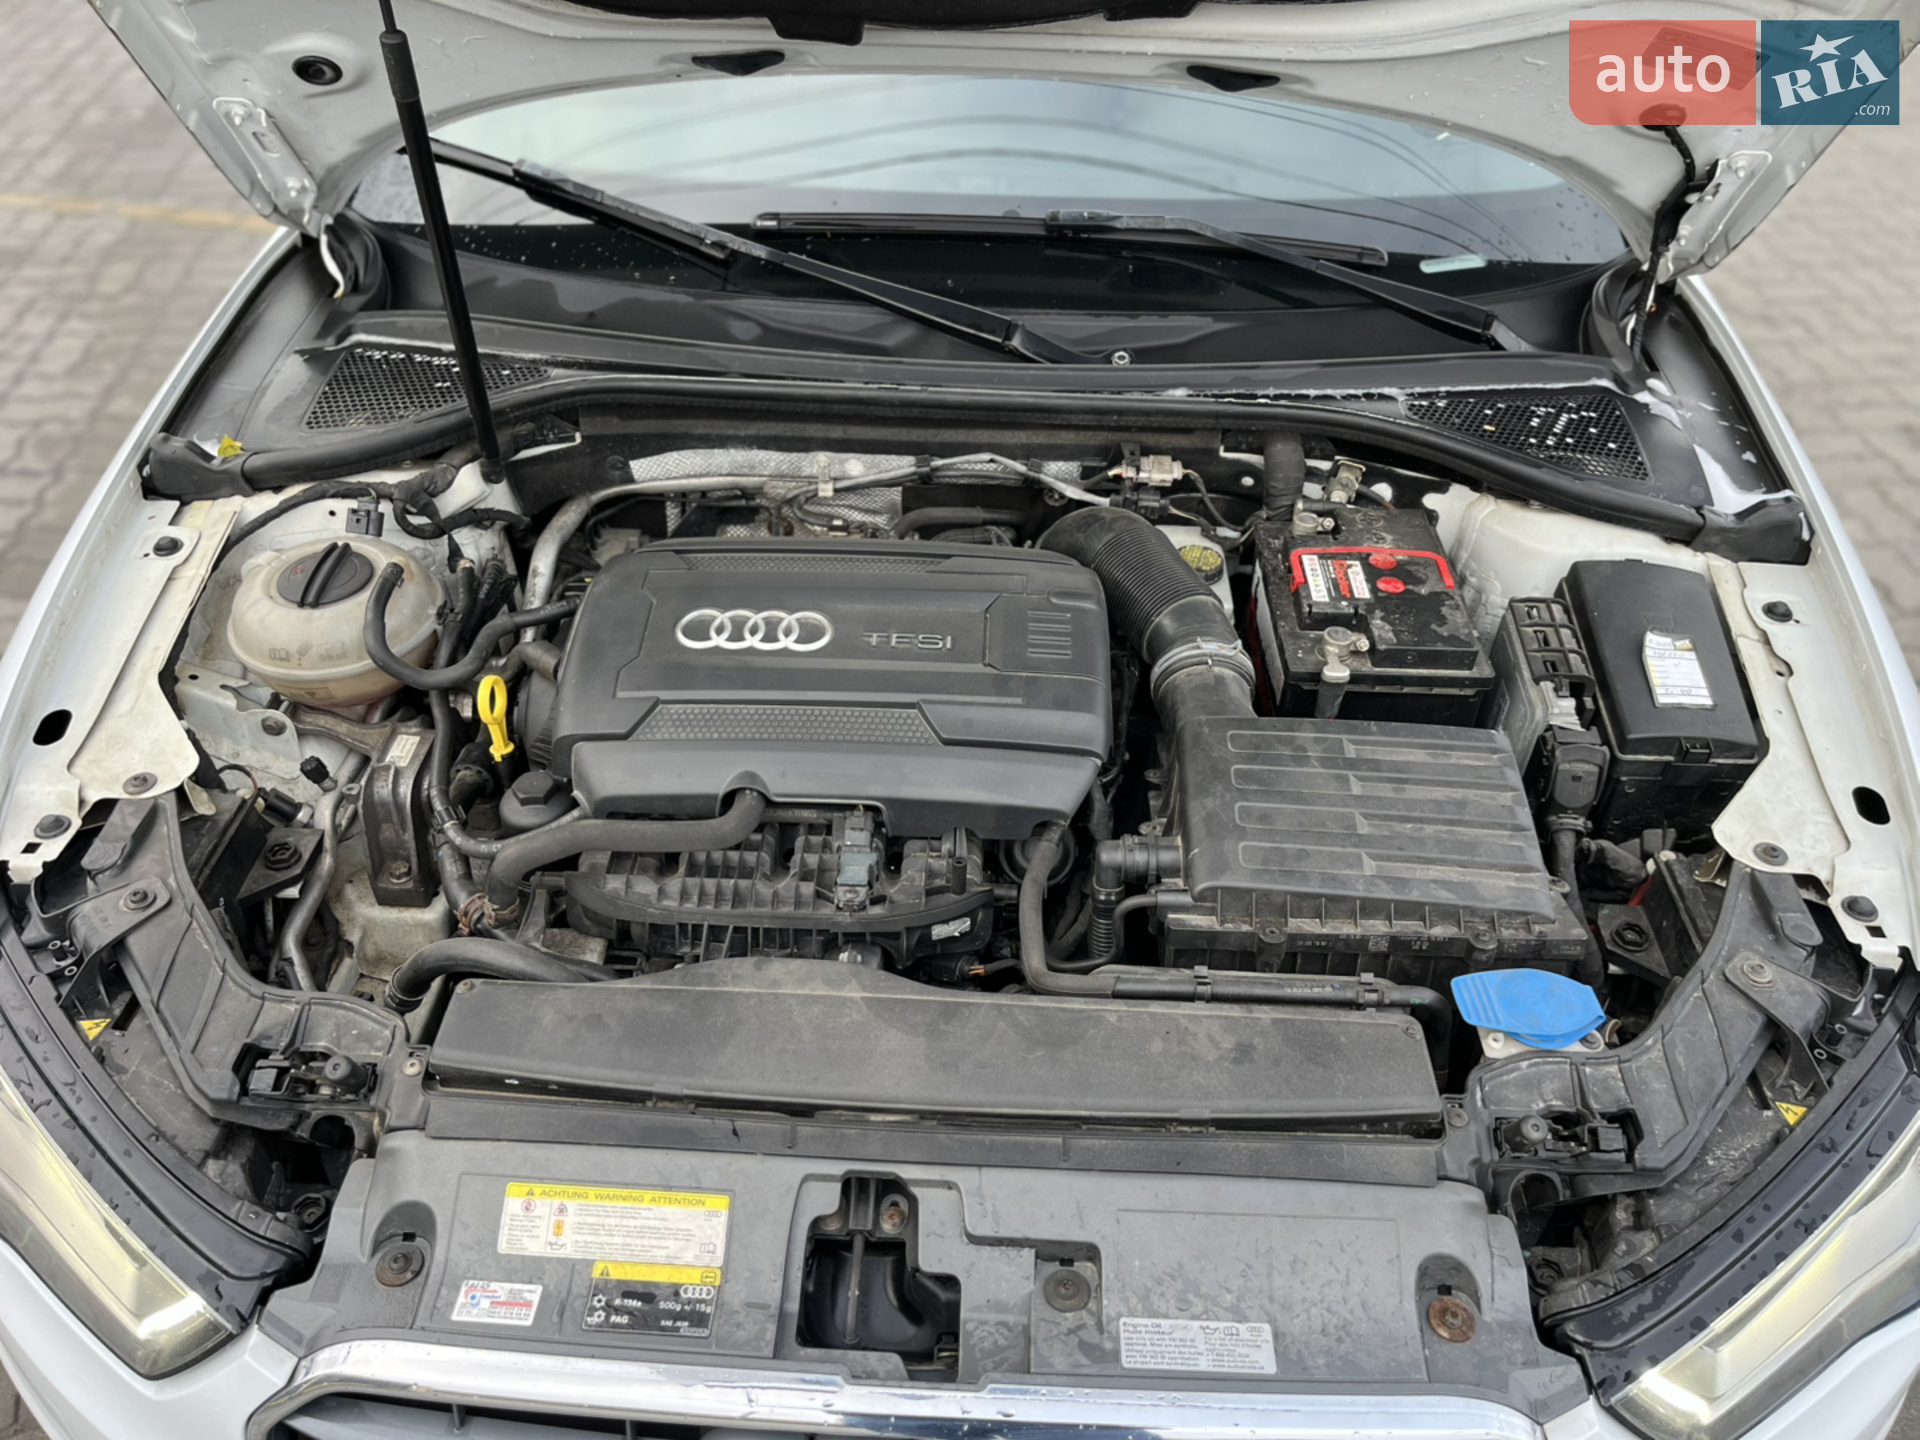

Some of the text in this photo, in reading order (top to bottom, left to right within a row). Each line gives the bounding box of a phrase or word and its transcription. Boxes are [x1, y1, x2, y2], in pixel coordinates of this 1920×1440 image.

[862, 632, 952, 649] TFSI
[540, 1189, 706, 1207] ACHTUNG WARNING ATTENTION
[659, 1301, 682, 1311] 500g
[610, 1315, 629, 1324] PAG
